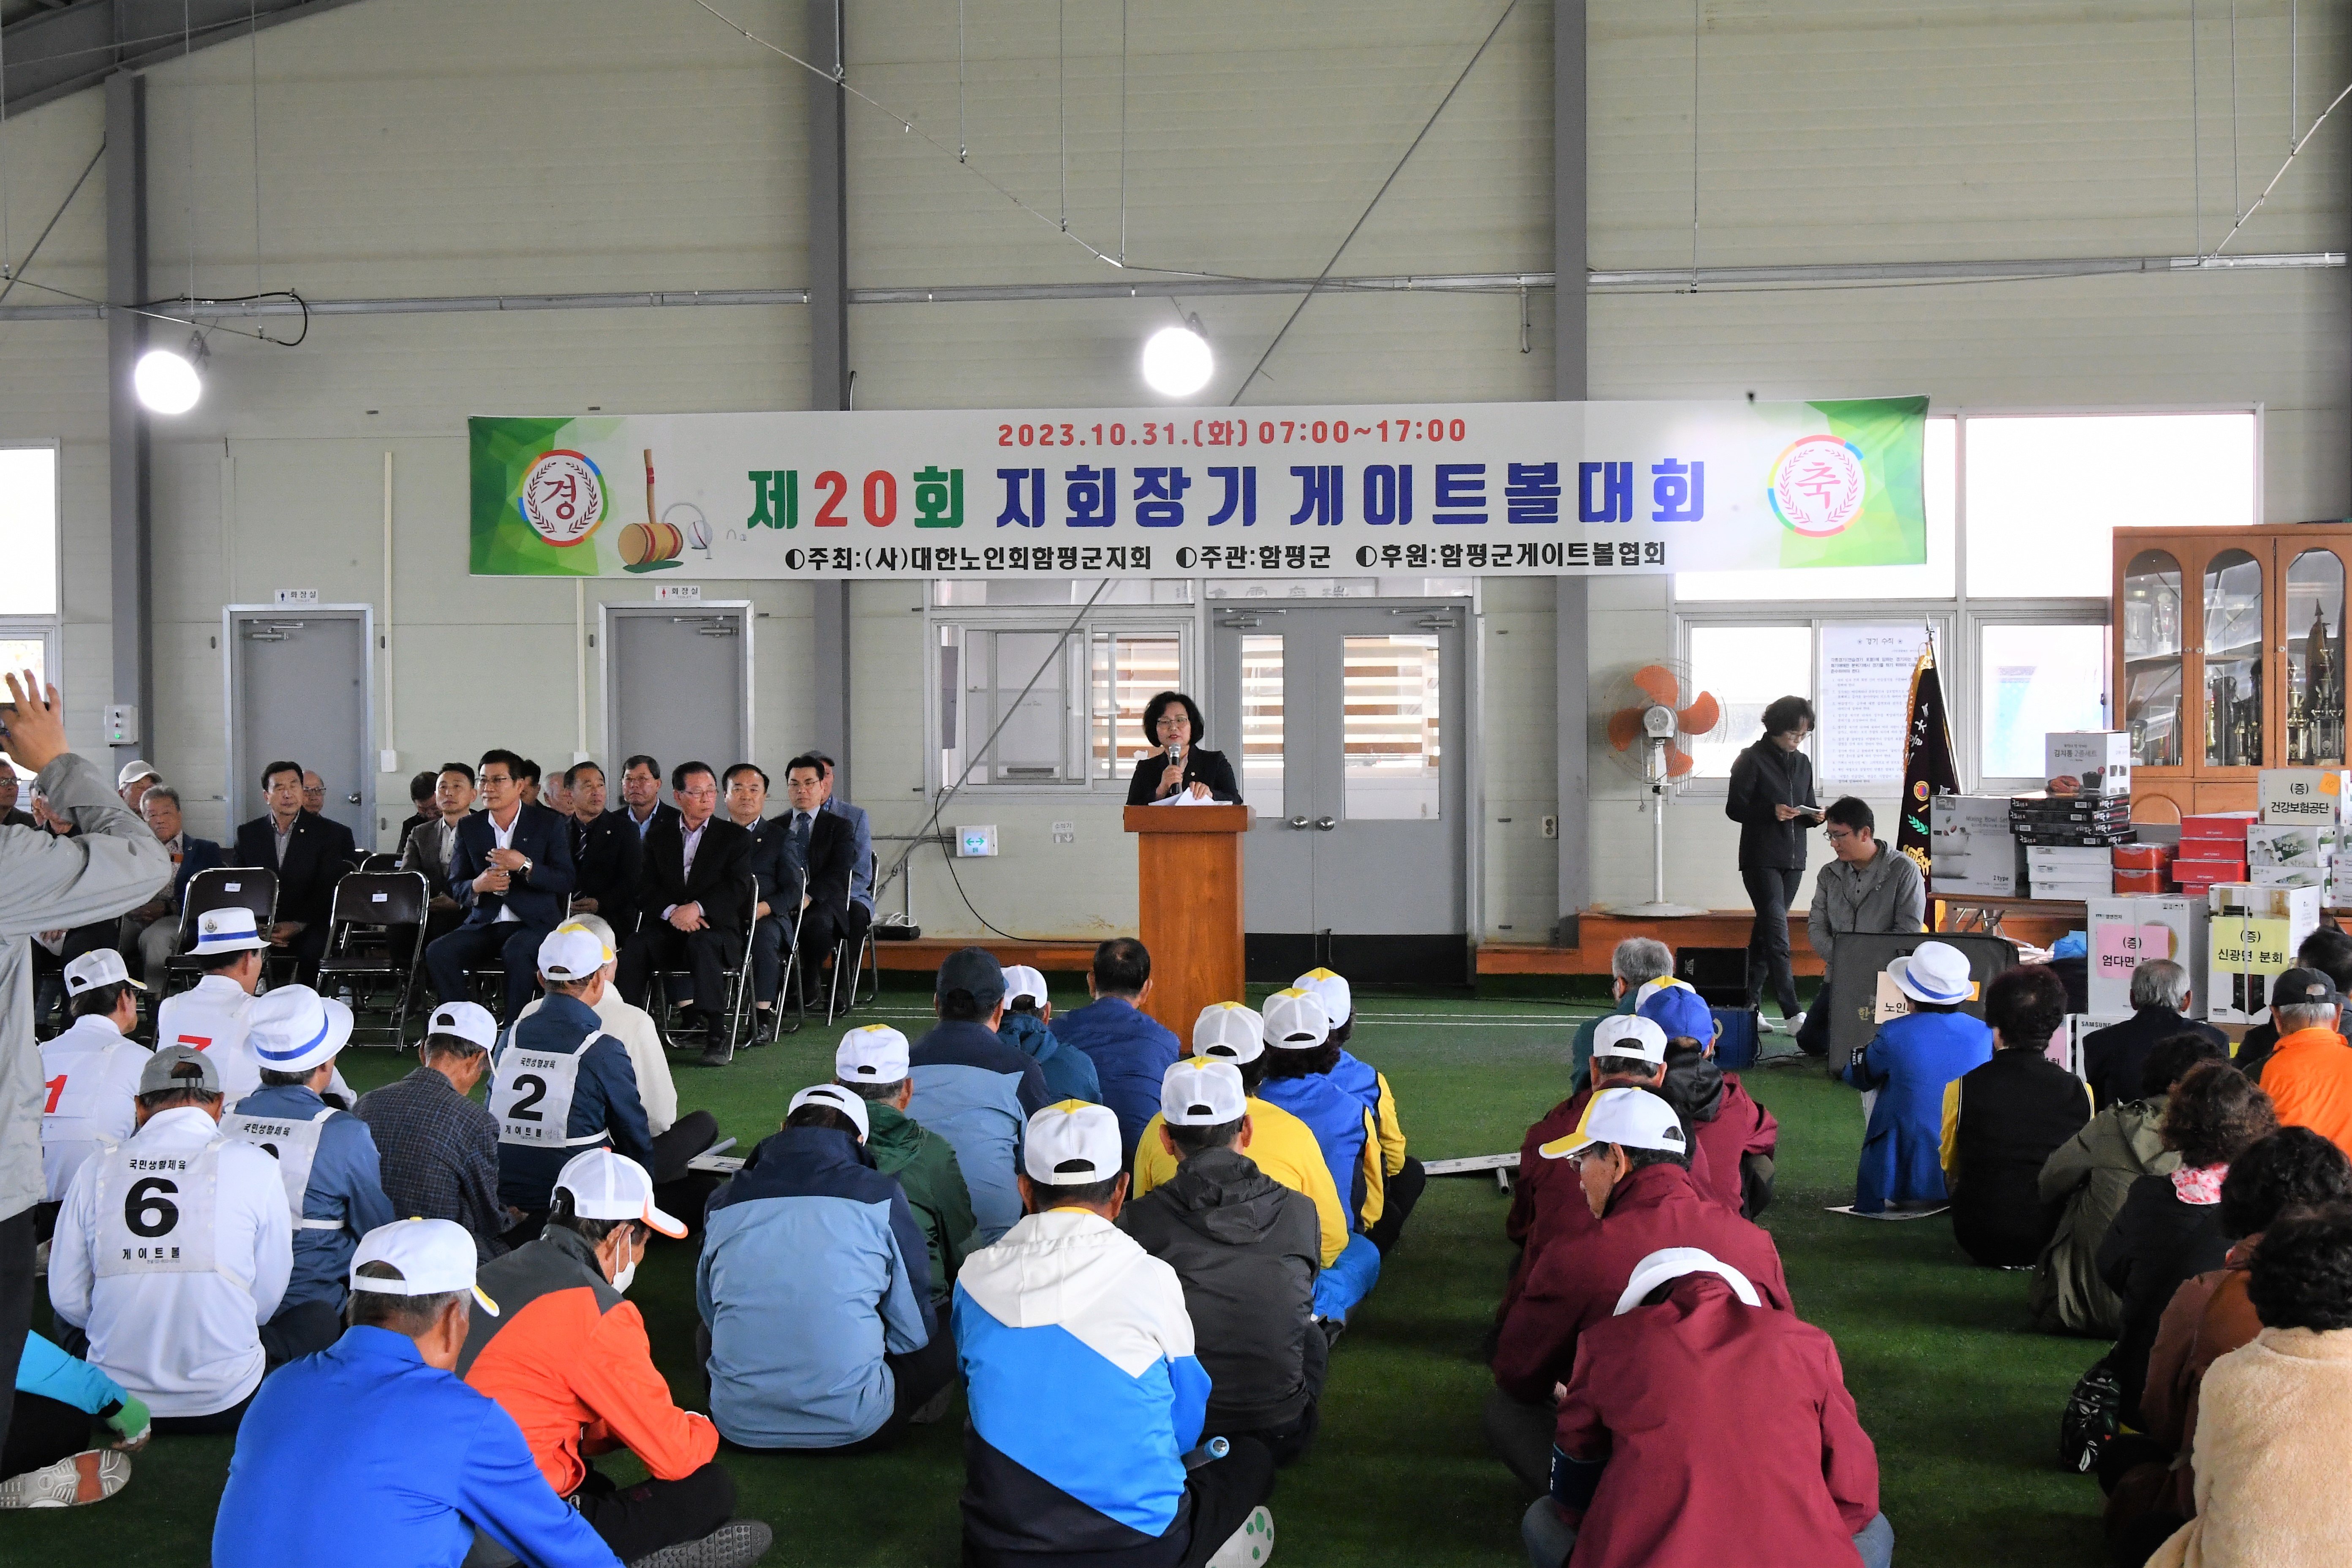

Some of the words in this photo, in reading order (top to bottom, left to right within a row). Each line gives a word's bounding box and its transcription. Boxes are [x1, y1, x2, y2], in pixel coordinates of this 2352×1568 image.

[999, 419, 1247, 448] 2023.10.31.(화)
[1259, 419, 1465, 444] 07:00~17:00
[1794, 461, 1841, 509] 축
[541, 474, 577, 520] 경
[748, 466, 964, 529] 제20회
[996, 466, 1257, 529] 지회장기
[1290, 457, 1706, 526] 게이트볼대회
[1200, 544, 1331, 569] 주관:함평군
[1380, 541, 1665, 569] 후원:함평군게이트볼협회
[290, 591, 316, 599] 화장실
[671, 587, 699, 595] 화장실
[2054, 749, 2072, 757] 김치통
[2290, 783, 2309, 795] (증)
[2271, 801, 2330, 814] 건강보험공단
[2102, 955, 2135, 968] 엄다면
[2259, 951, 2283, 964] 분회
[1884, 1002, 1909, 1013] 노인
[508, 1073, 547, 1122] 2
[505, 1124, 542, 1138] 게이트볼
[124, 1176, 180, 1238] 6
[122, 1247, 180, 1260] 게이트볼
